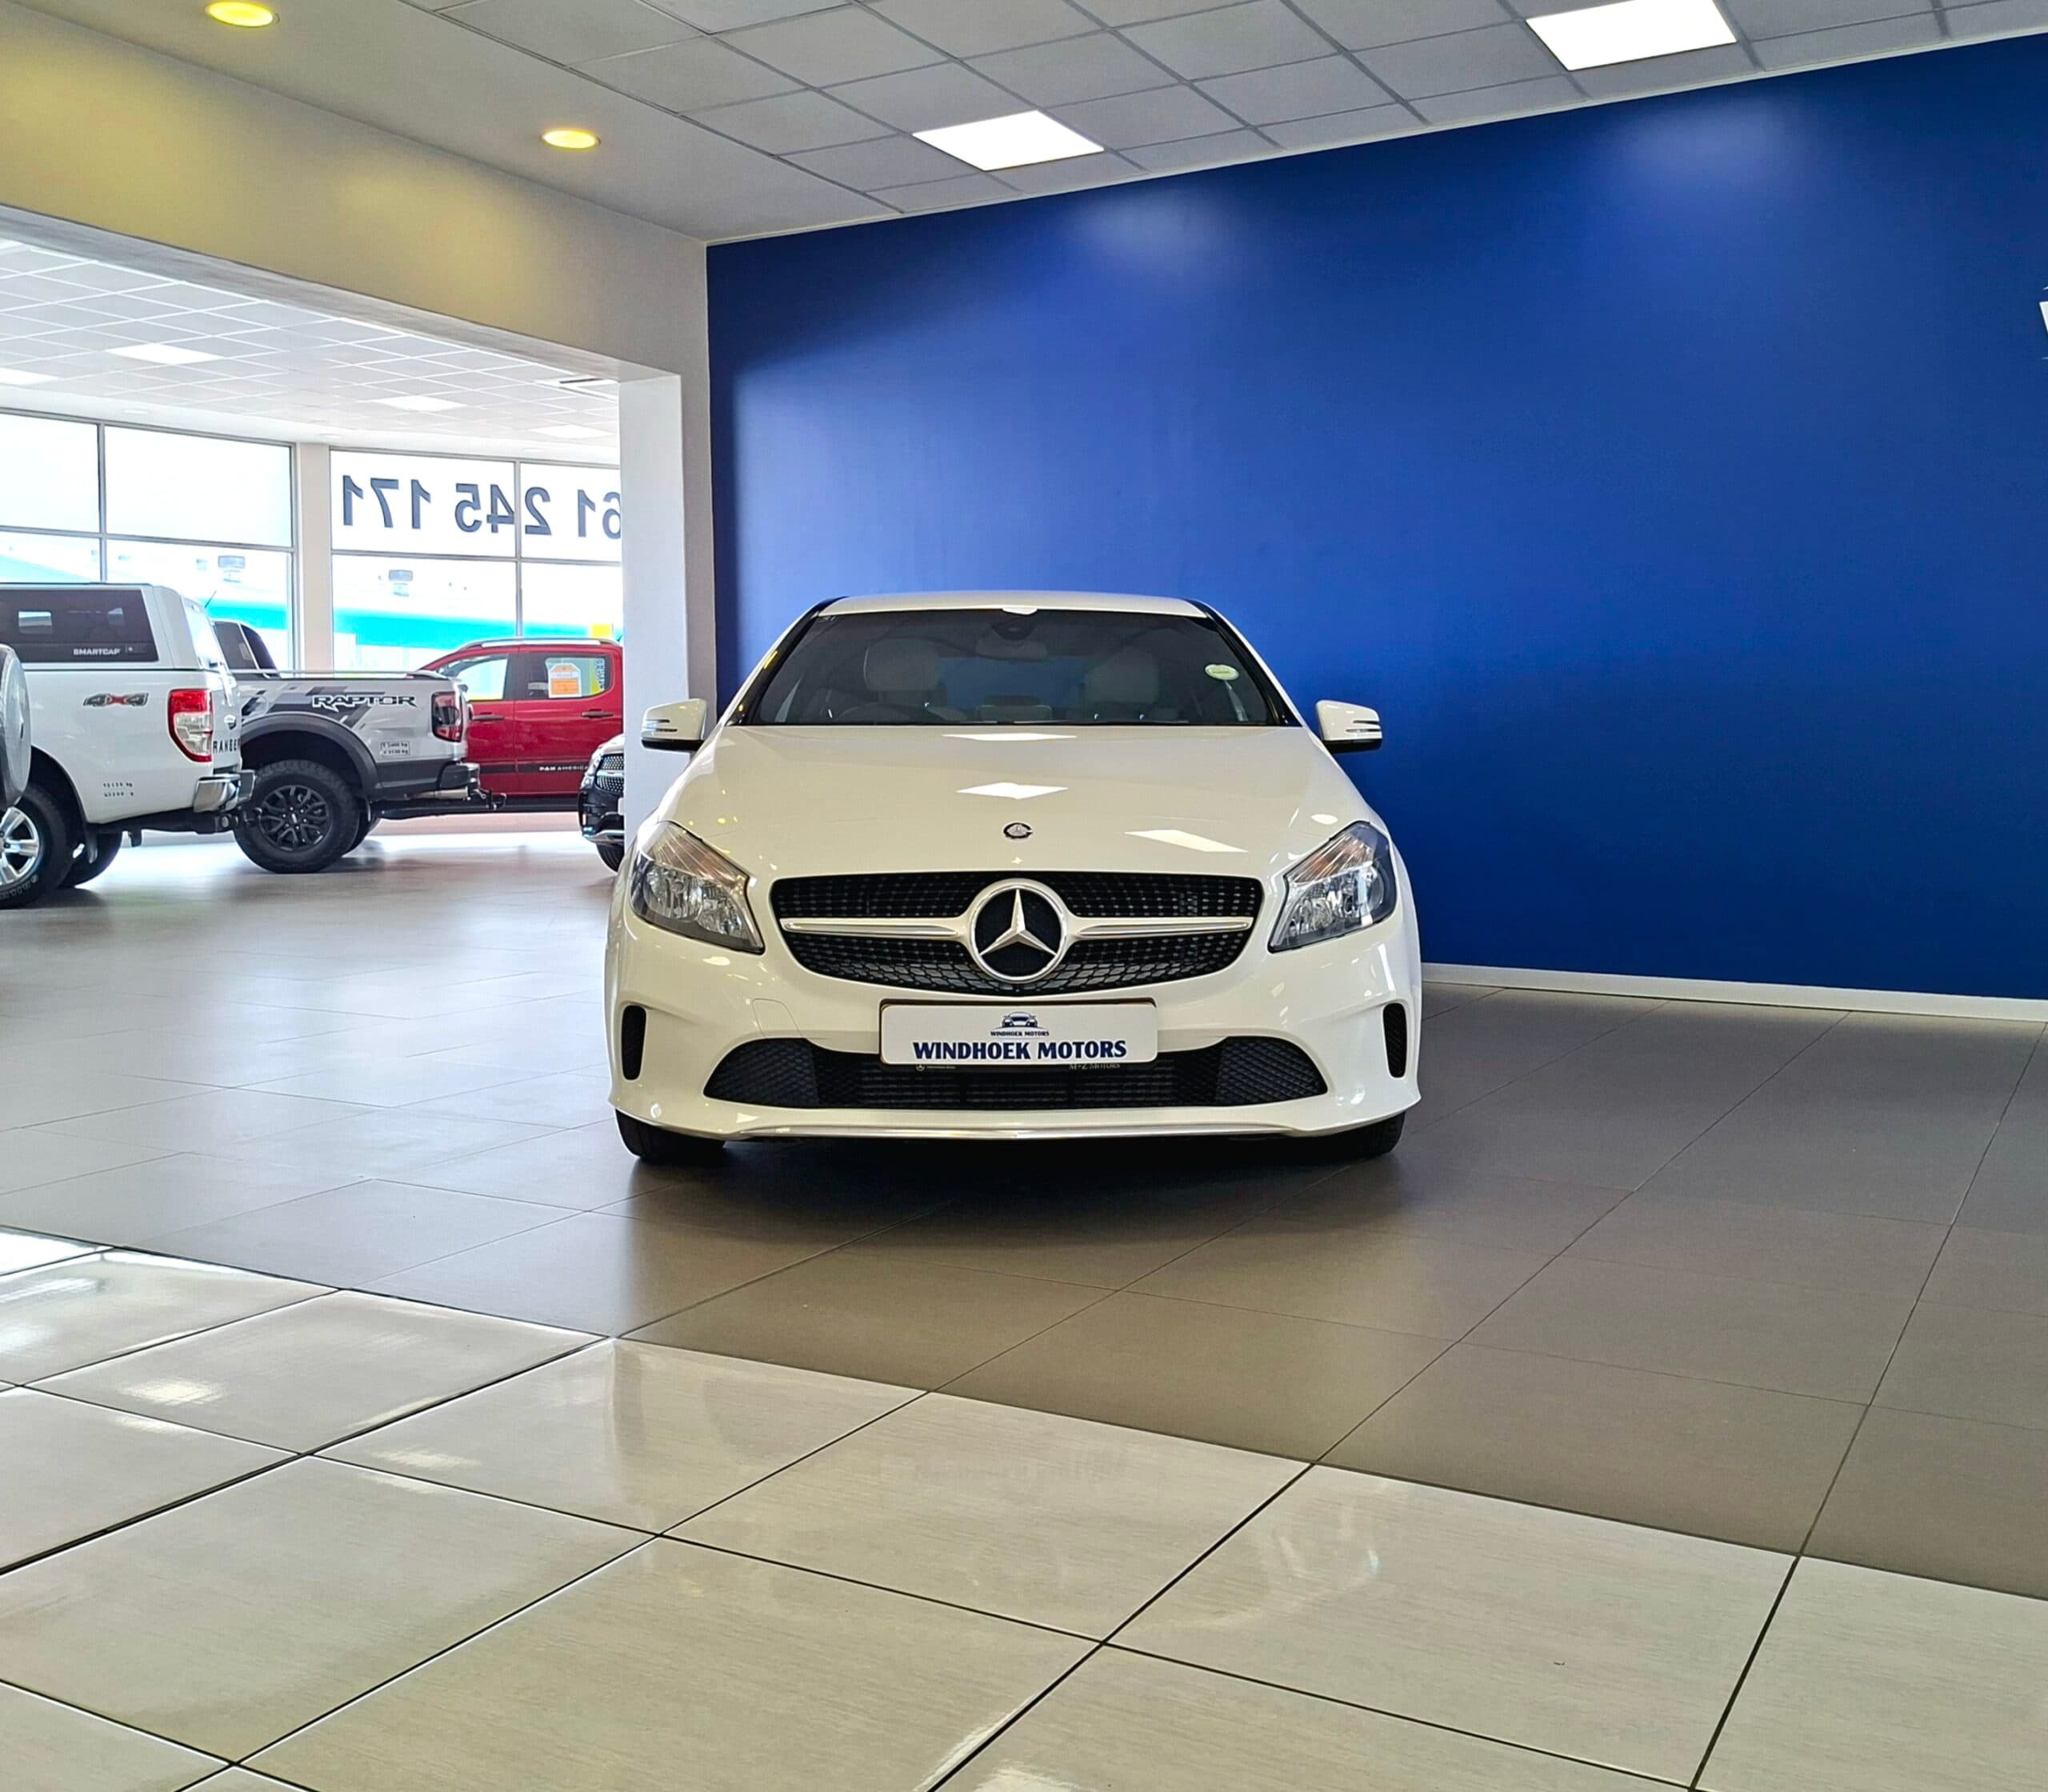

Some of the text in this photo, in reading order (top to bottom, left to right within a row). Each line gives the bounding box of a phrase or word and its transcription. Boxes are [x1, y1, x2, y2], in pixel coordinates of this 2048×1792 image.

[73, 648, 121, 656] SMARTCAP
[312, 694, 418, 712] RAPTOR
[912, 1040, 1127, 1060] WINDHOEK MOTORS
